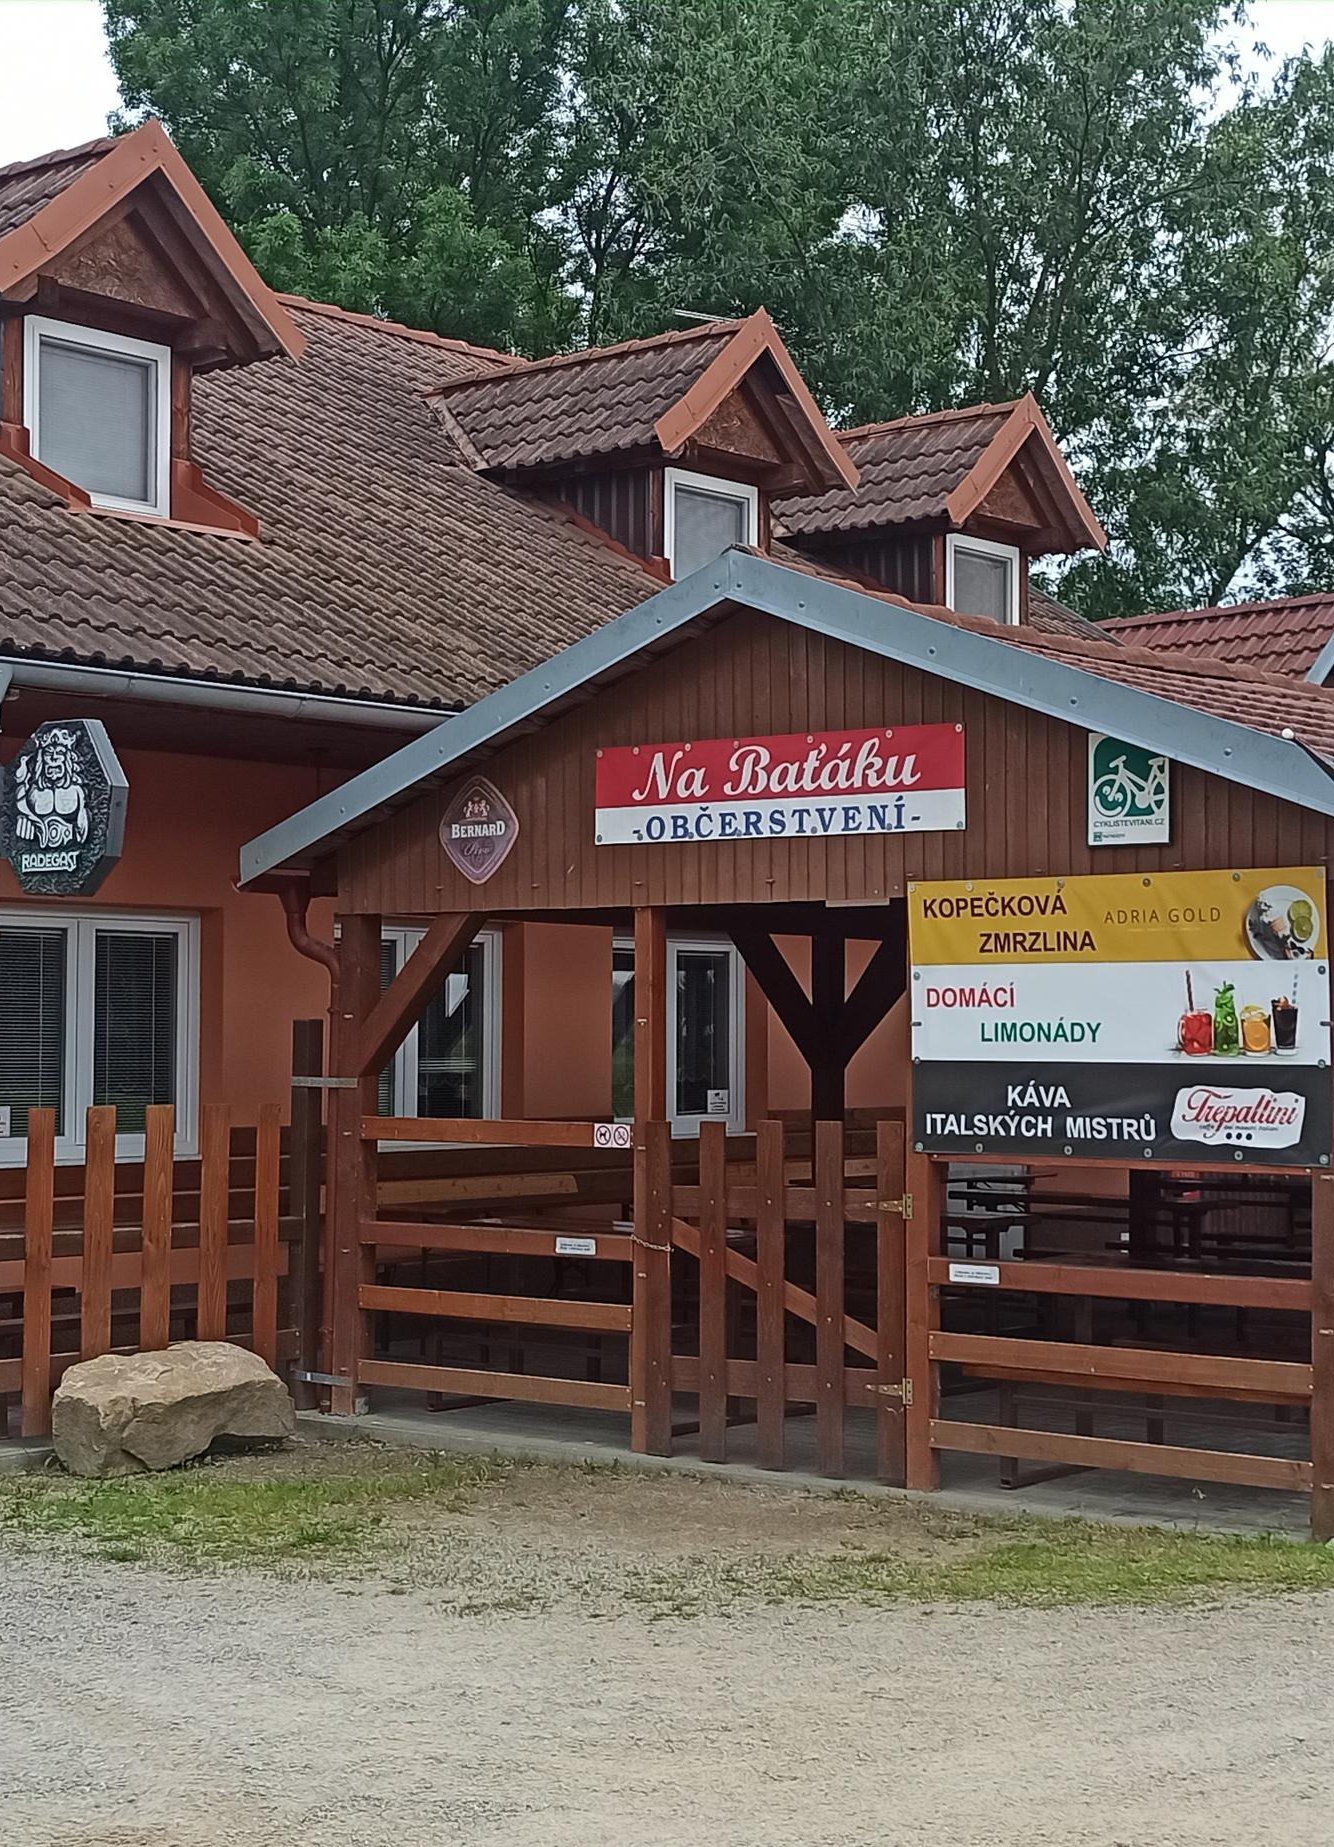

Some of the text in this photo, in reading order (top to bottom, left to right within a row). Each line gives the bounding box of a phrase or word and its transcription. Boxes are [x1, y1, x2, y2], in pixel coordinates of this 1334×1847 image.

[632, 738, 921, 800] Na Baťáku
[451, 821, 506, 839] BERNARD
[21, 851, 79, 873] RADEGAST
[923, 889, 1067, 919] KOPEČKOVÁ
[1104, 907, 1221, 924] ADRIA GOLD
[979, 930, 1096, 954] ZMRZLINA
[926, 982, 1015, 1008] DOMÁCÍ
[980, 1017, 1102, 1043] LIMONÁDY
[1006, 1080, 1072, 1108] KÁVA
[925, 1109, 1156, 1141] ITALSKÝCH MISTRŮ
